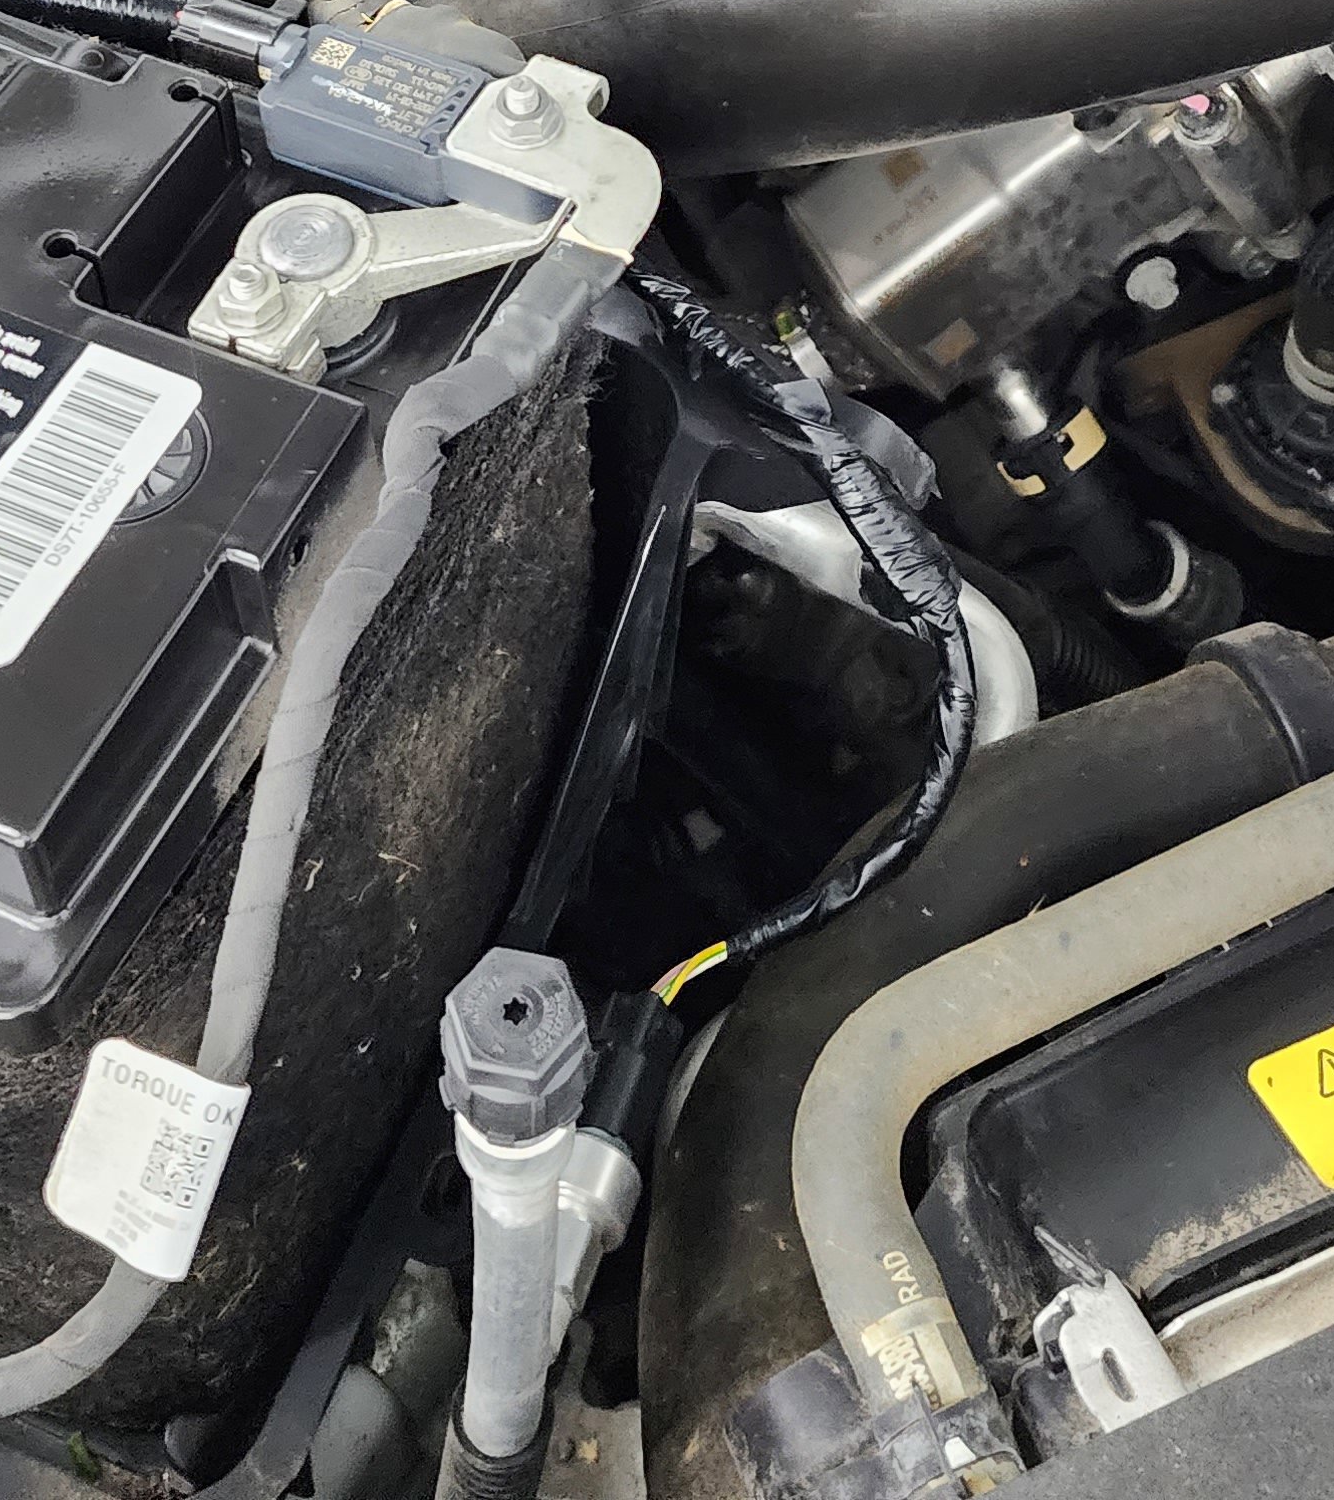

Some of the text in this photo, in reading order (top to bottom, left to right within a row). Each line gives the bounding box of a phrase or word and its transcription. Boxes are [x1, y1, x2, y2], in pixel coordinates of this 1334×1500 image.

[372, 113, 421, 138] FoMoCo
[43, 461, 127, 567] DS7T-10655-F
[98, 1054, 236, 1128] TORQUE OK
[883, 1251, 921, 1302] RAD
